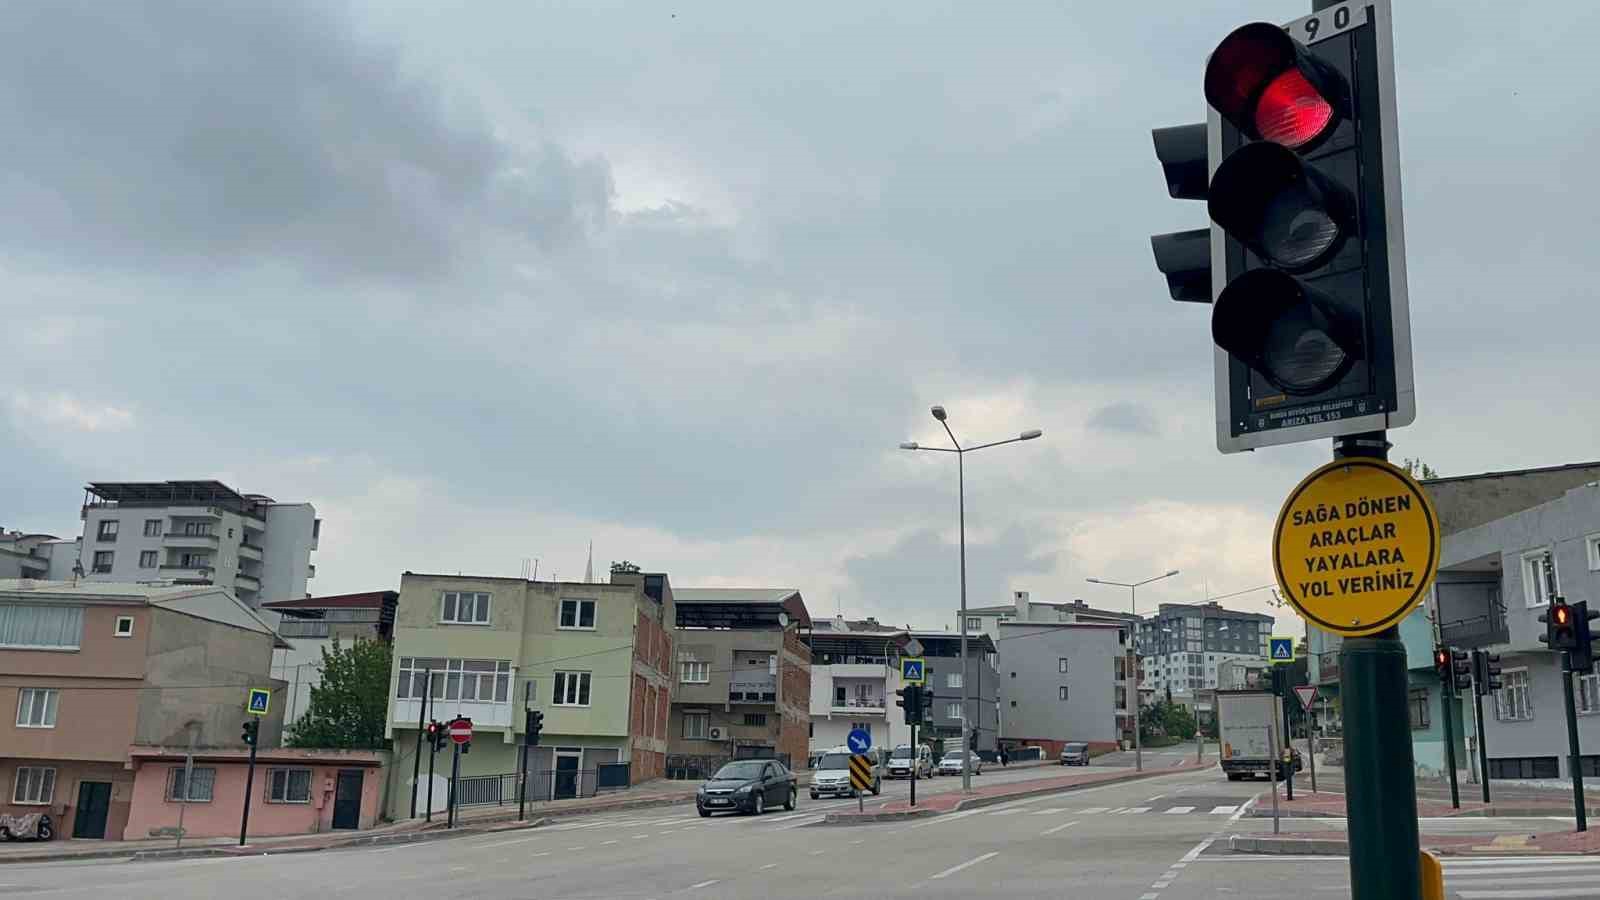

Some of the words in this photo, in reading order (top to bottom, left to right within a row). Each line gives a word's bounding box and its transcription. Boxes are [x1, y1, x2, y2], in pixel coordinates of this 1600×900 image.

[1284, 6, 1350, 41] 90
[1293, 504, 1340, 525] SAĞA
[1345, 495, 1411, 518] DÖNEN
[1310, 522, 1397, 549] ARAÇLAR
[1305, 547, 1405, 573] YAYALARA
[1299, 581, 1334, 598] YOL
[1338, 568, 1415, 595] VERİNİZ
